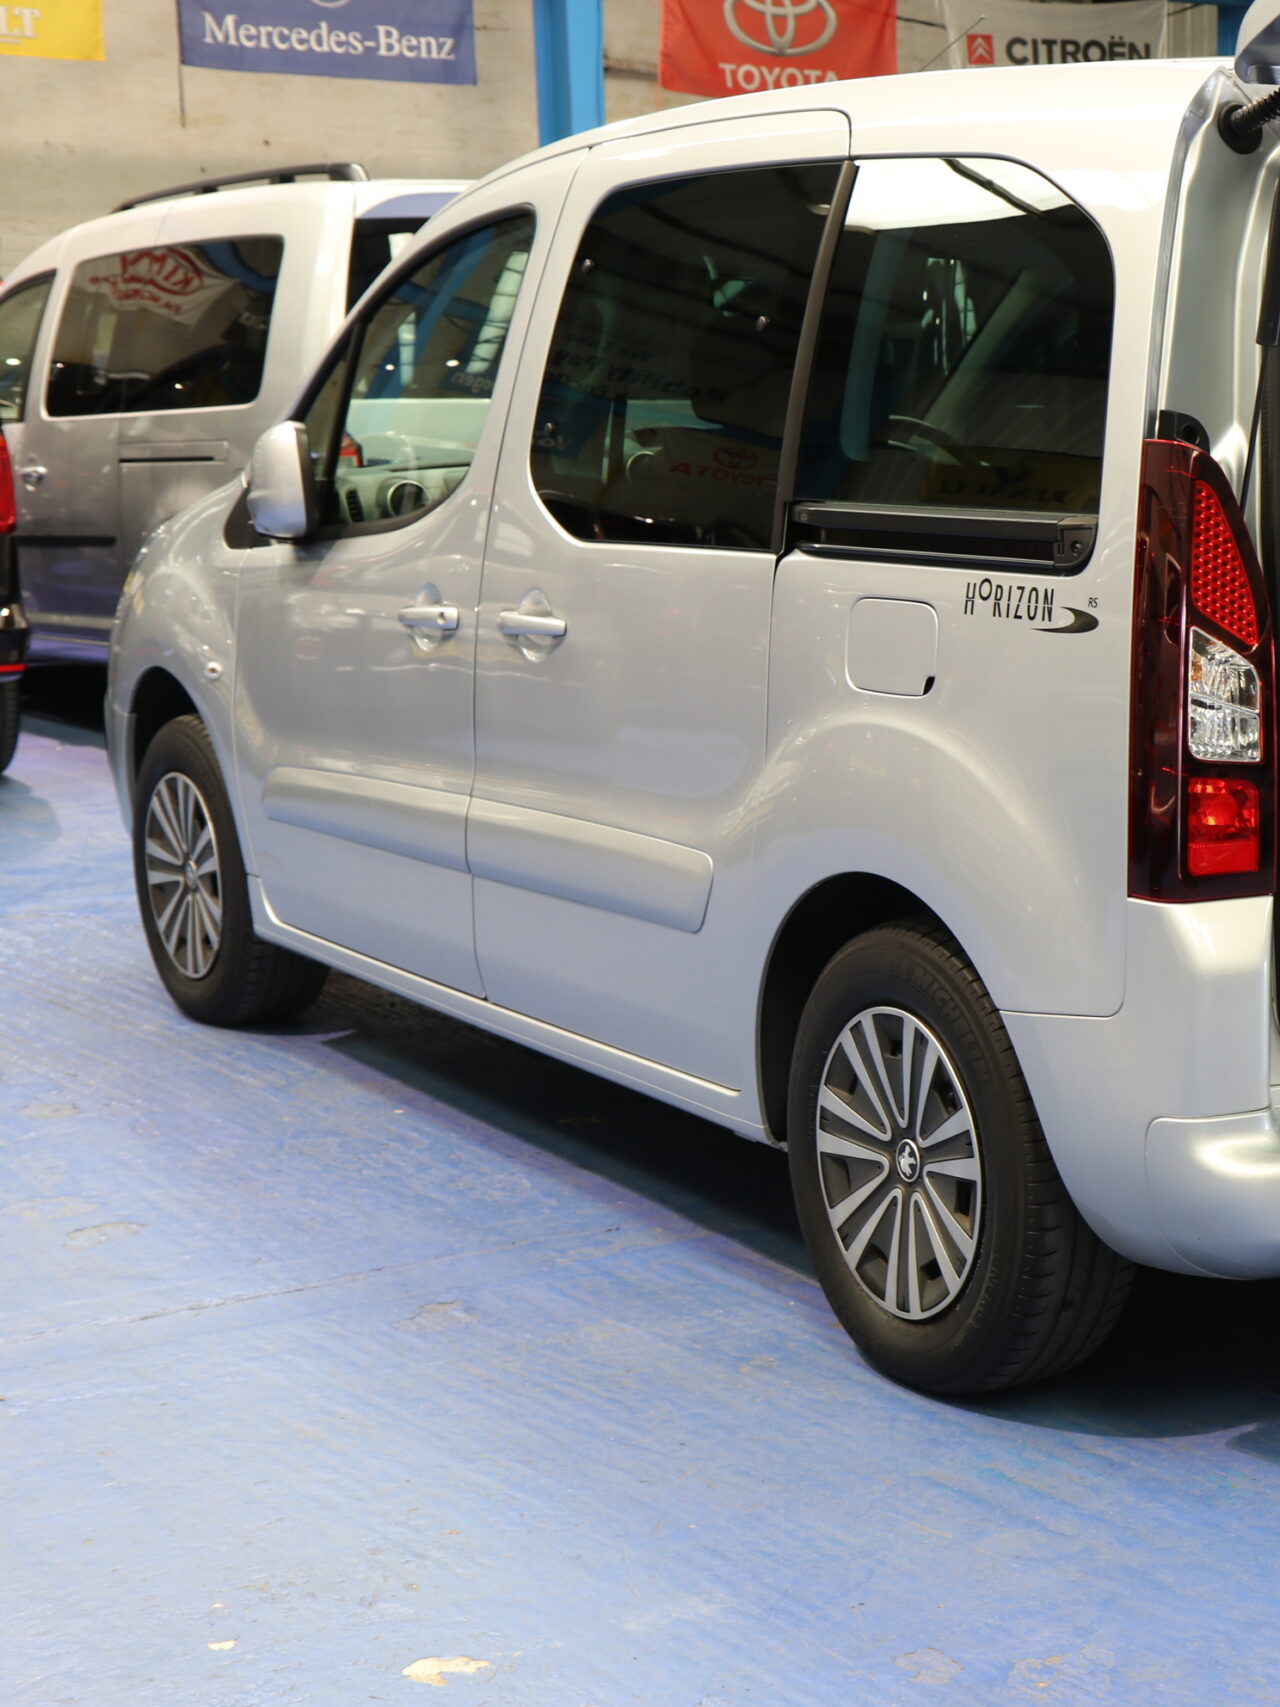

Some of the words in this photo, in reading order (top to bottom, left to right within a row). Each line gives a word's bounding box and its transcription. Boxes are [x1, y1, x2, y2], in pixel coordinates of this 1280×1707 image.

[202, 11, 455, 60] Mercedes-Benz
[1005, 35, 1150, 64] CITROËN
[964, 578, 1054, 622] HORIZON
[1087, 597, 1098, 608] RS
